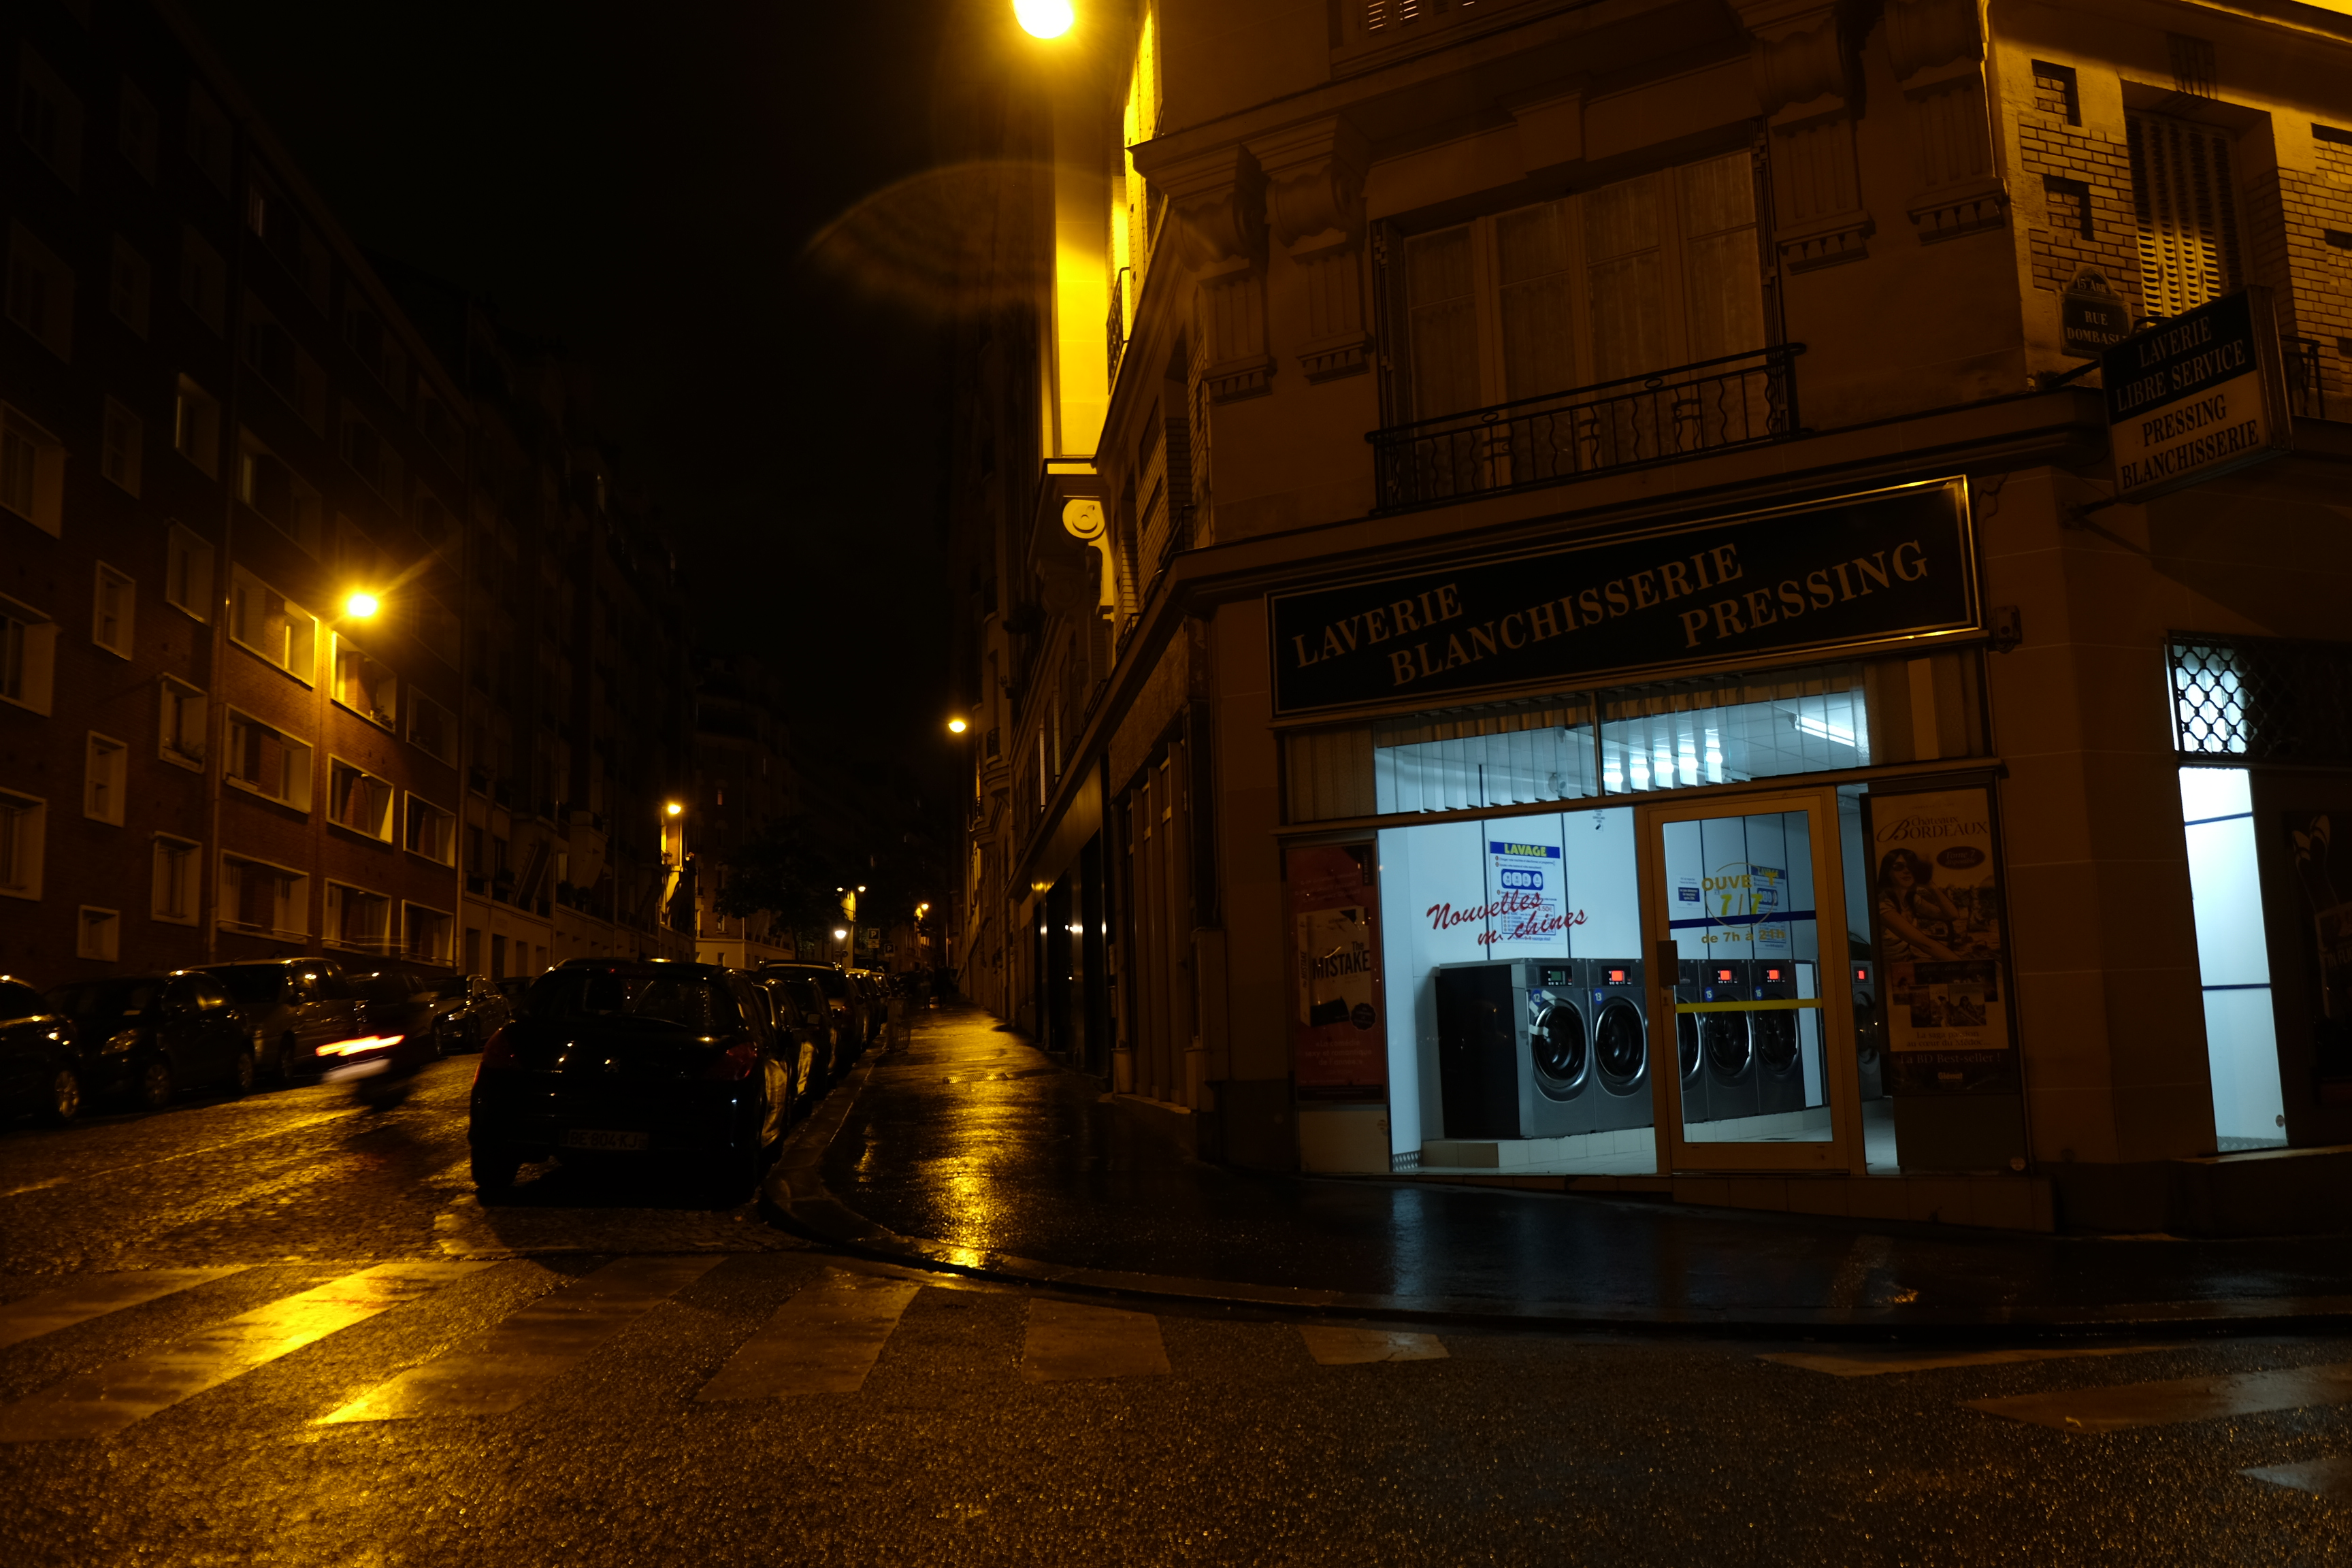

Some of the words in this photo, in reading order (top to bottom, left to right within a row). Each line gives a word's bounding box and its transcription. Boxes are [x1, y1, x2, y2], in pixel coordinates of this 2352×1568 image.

[2084, 310, 2108, 326] RUE
[2066, 327, 2127, 345] DOMBASL
[2138, 316, 2212, 368] LAVERIE
[2116, 371, 2167, 412] LIBRE
[2171, 339, 2246, 391] SERVICE
[2142, 394, 2226, 447] PRESSING
[2121, 419, 2259, 490] BLANCHISSERIE
[1678, 540, 1929, 649] PRESSING
[1388, 542, 1744, 687] BLANCHISSERIE
[1292, 583, 1464, 668] LAVERIE
[1504, 843, 1547, 857] LAVAGE
[1946, 851, 1968, 860] Tome
[1702, 871, 1779, 892] OUVET
[1426, 889, 1544, 930] Nouvelles
[1477, 909, 1588, 946] mchines
[1351, 941, 1364, 951] The
[1701, 934, 1718, 944] de
[1722, 932, 1740, 942] 7h
[1745, 930, 1754, 941] à
[1311, 950, 1371, 980] MISTAKE
[1533, 994, 1541, 1002] 12
[1595, 992, 1602, 1001] 13
[1705, 990, 1712, 999] 15
[1318, 1058, 1328, 1066] de
[1900, 1054, 1913, 1064] La
[1917, 1054, 1933, 1064] BD
[1937, 1052, 1993, 1063] Best-seller
[1938, 1071, 1963, 1080] Glénat
